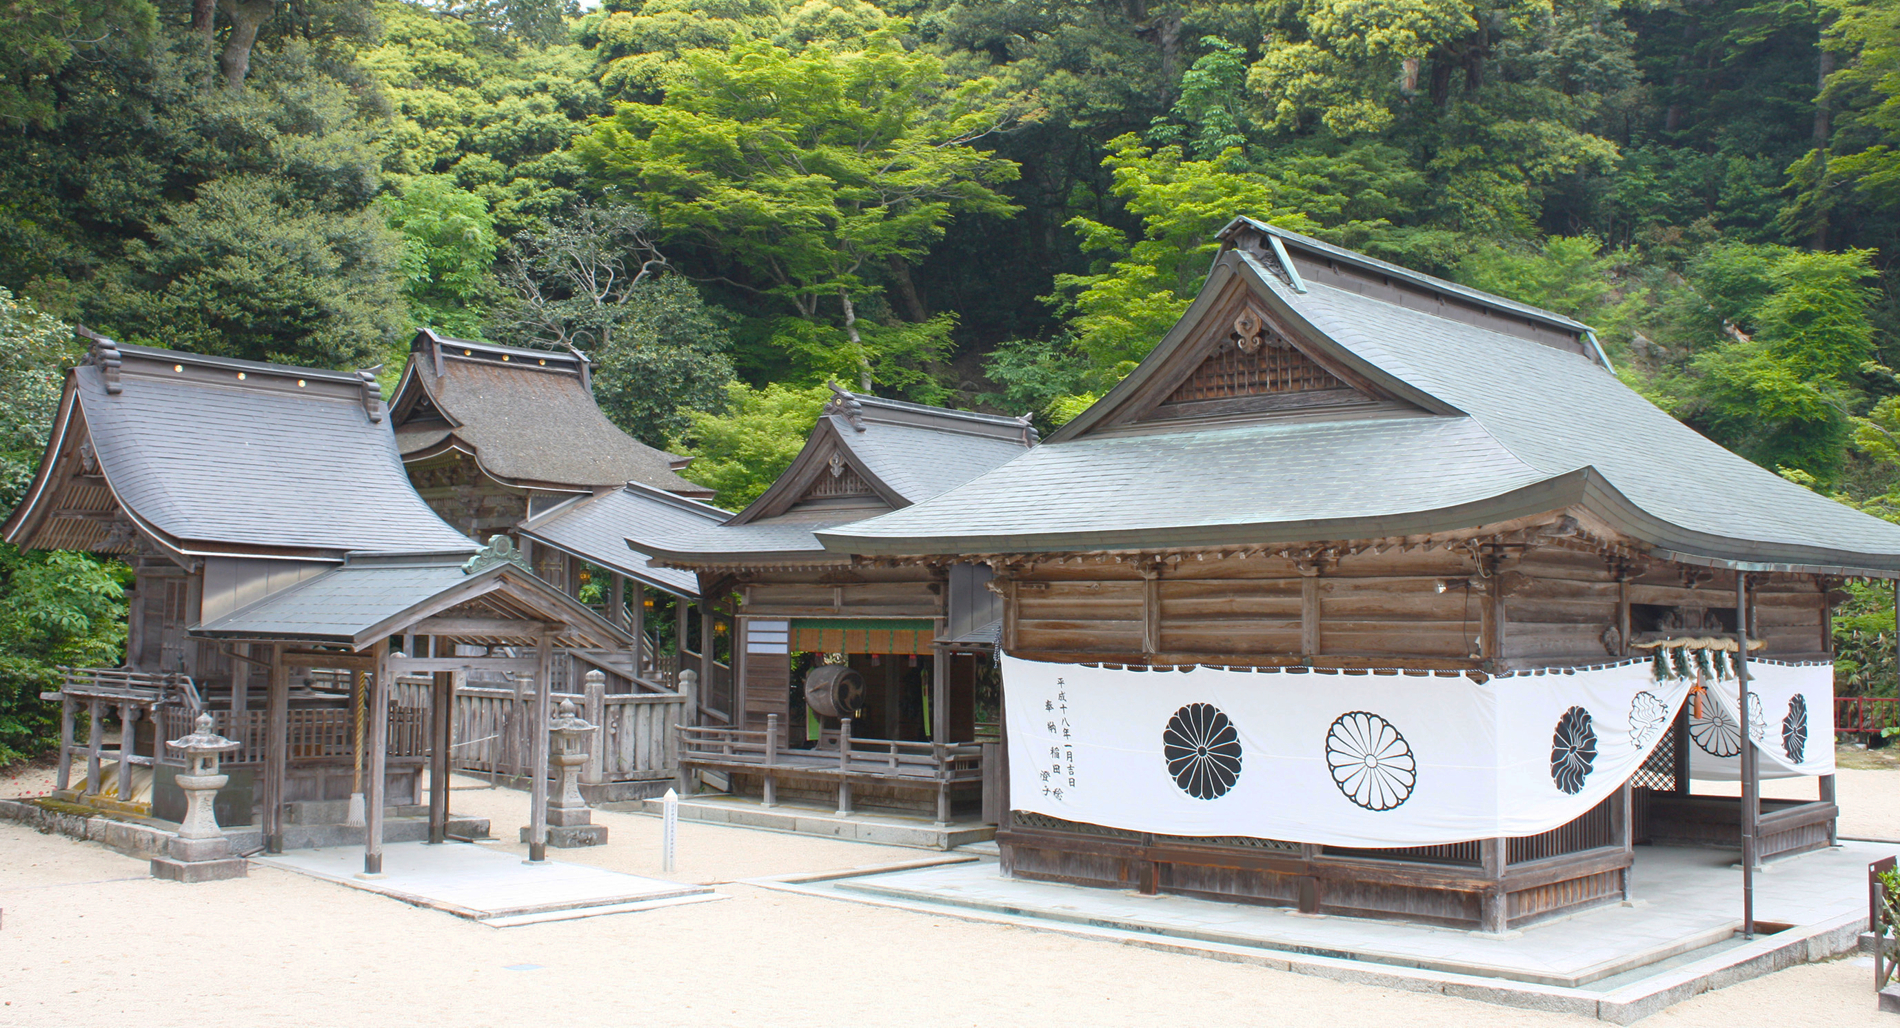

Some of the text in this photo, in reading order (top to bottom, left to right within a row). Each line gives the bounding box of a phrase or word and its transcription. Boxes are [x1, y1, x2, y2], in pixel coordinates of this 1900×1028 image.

[1057, 677, 1075, 787] 平成十八年一月吉日
